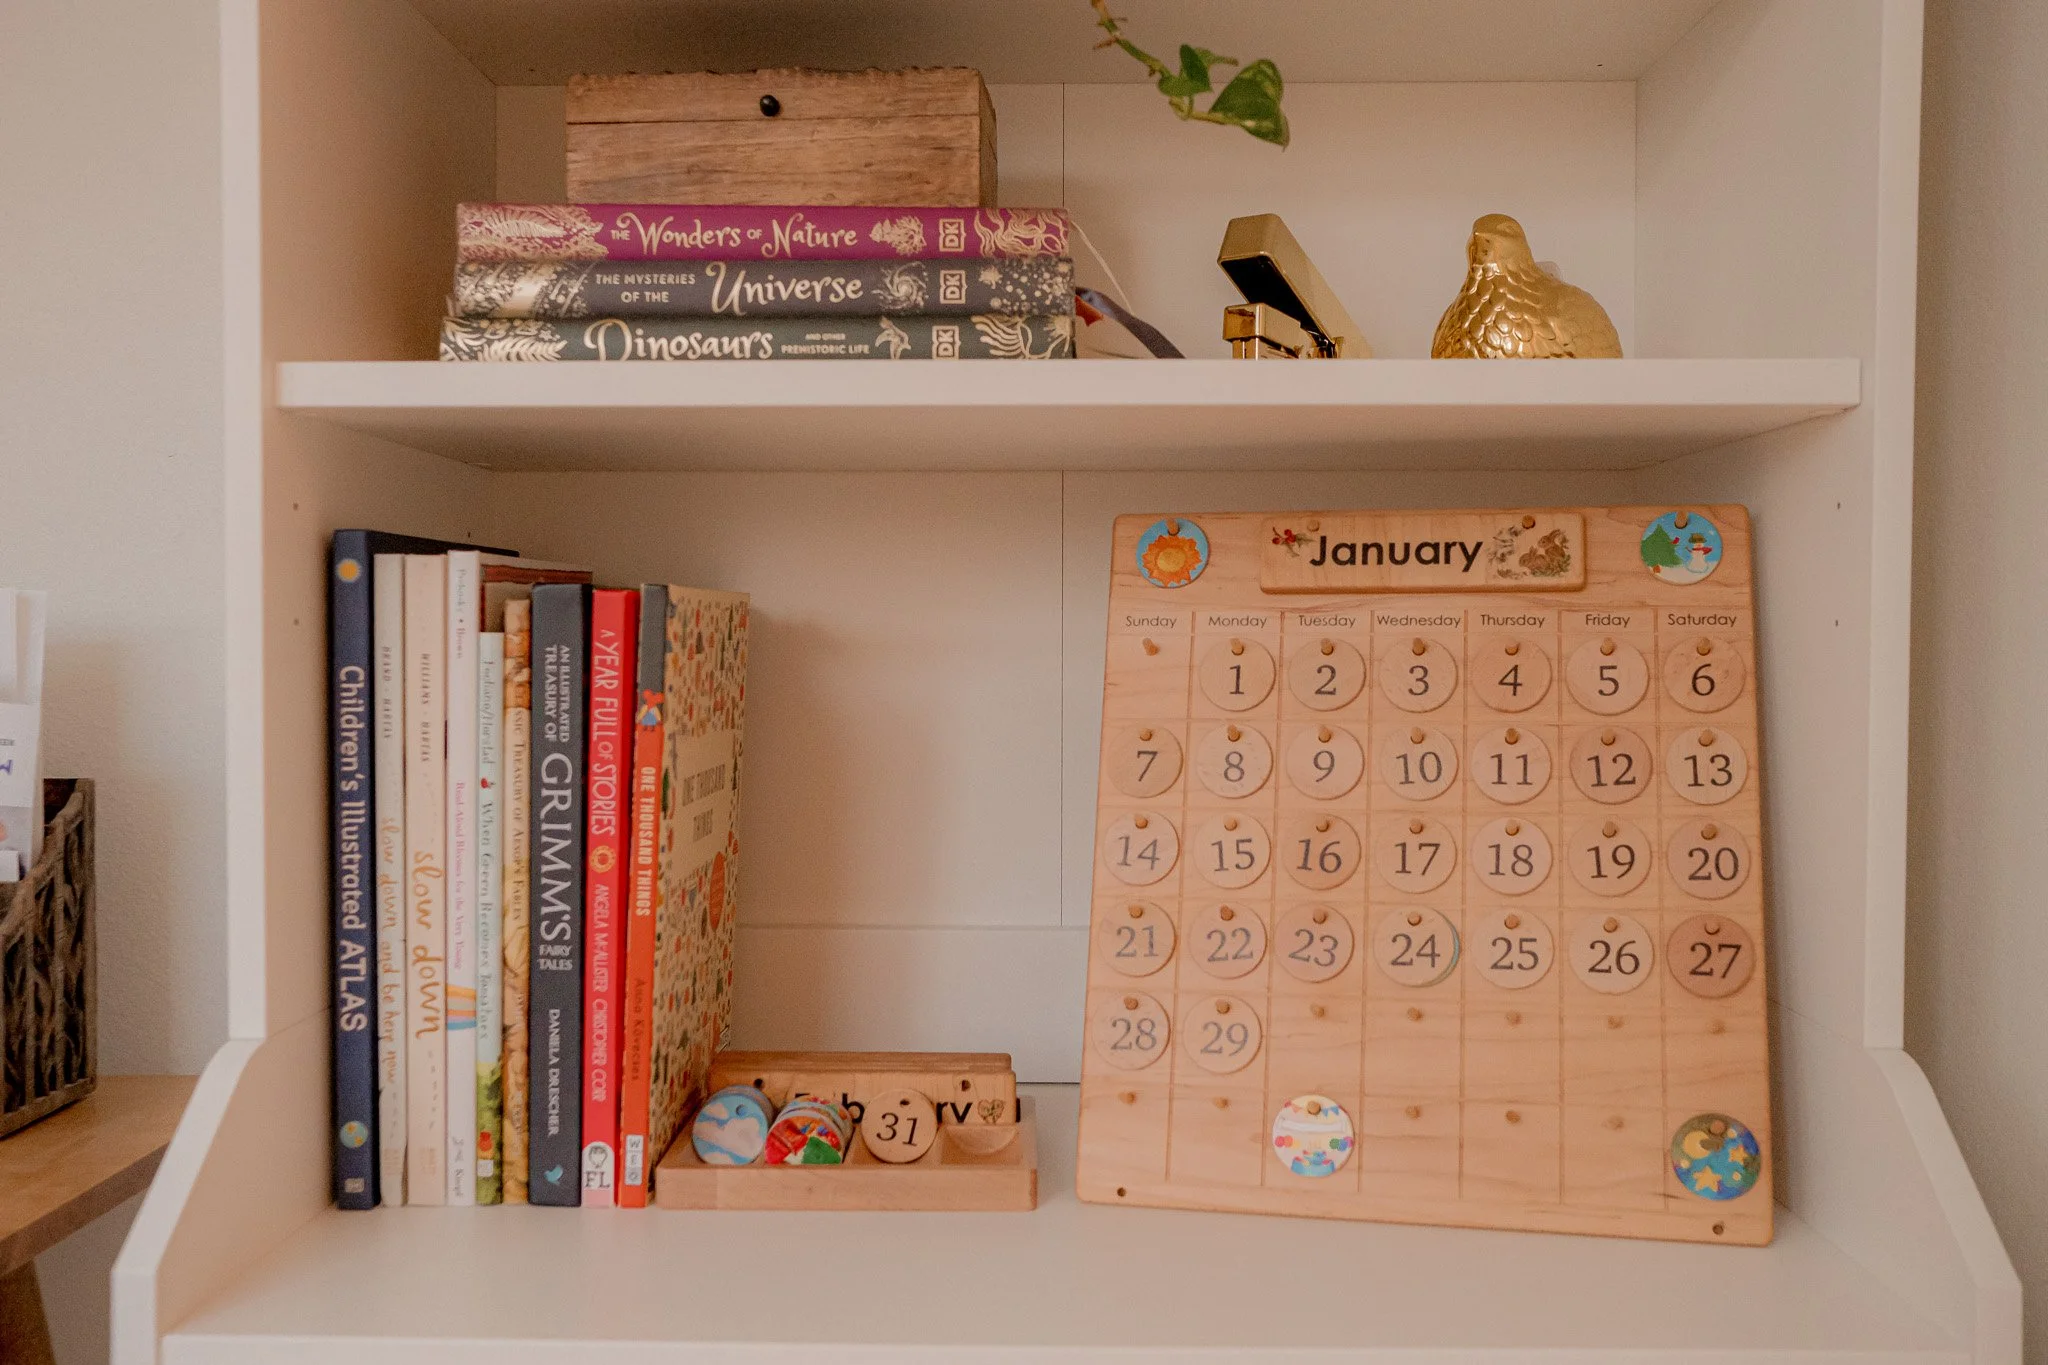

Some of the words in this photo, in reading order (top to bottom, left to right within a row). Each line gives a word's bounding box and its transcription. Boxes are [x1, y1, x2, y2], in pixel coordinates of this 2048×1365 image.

[611, 229, 631, 241] THE
[616, 211, 742, 255] Wonders
[746, 228, 762, 240] OF
[761, 212, 858, 258] Nature
[943, 222, 960, 249] DK
[596, 274, 620, 285] THE
[624, 274, 696, 285] MYSTERIES
[621, 292, 639, 303] OF
[643, 292, 669, 303] THE
[705, 261, 863, 316] Universe
[943, 272, 962, 300] DK
[583, 318, 774, 360] Dinosaurs
[781, 344, 847, 355] PREHISTORIC
[848, 344, 870, 355] LIFE
[935, 331, 956, 359] DK
[1309, 535, 1484, 573] January
[600, 629, 616, 639] A
[1125, 615, 1177, 629] Sunday
[1208, 615, 1268, 629] Monday
[1299, 615, 1356, 629] Tuesday
[1376, 614, 1461, 628] Wednesday
[1480, 614, 1545, 629] Thursday
[1585, 613, 1630, 628] Friday
[1667, 613, 1738, 628] Saturday
[559, 644, 570, 663] AN
[594, 641, 620, 690] YEAR
[544, 644, 558, 717] TREASURY
[1229, 664, 1245, 695] 1
[1314, 664, 1337, 696] 2
[1408, 665, 1430, 696] 3
[1498, 664, 1523, 697] 4
[1598, 665, 1620, 697] 5
[1691, 663, 1715, 697] 6
[558, 665, 571, 743] ILLUSTRATED
[592, 697, 619, 742] FULL
[338, 665, 367, 792] Children's
[544, 722, 557, 742] OF
[598, 741, 614, 760] OF
[1137, 750, 1158, 782] 7
[1223, 751, 1245, 783] 8
[1313, 750, 1335, 783] 9
[1395, 751, 1443, 785] 10
[1490, 753, 1533, 786] 11
[1587, 753, 1636, 787] 12
[1684, 754, 1733, 787] 13
[639, 766, 657, 792] ONE
[591, 762, 618, 837] STORIES
[381, 817, 401, 864] slow
[480, 800, 494, 845] When
[638, 797, 657, 865] THOUSAND
[339, 801, 367, 930] Illustrated
[540, 753, 573, 941] GRIMM'S
[1118, 835, 1160, 871] 14
[1211, 838, 1255, 872] 15
[1297, 838, 1342, 874] 16
[1395, 841, 1441, 876] 17
[1488, 843, 1534, 877] 18
[1587, 844, 1635, 879] 19
[1688, 847, 1739, 881] 20
[412, 851, 445, 930] slow
[480, 852, 495, 897] Green
[635, 869, 653, 917] THINGS
[380, 873, 400, 932] down
[454, 897, 465, 911] the
[594, 883, 610, 929] ANGELA
[380, 940, 401, 974] and
[538, 958, 573, 971] TALES
[539, 944, 571, 956] FAIRY
[1115, 925, 1159, 958] 21
[1206, 927, 1254, 963] 22
[1288, 928, 1339, 967] 23
[1390, 933, 1441, 968] 24
[1490, 936, 1539, 971] 25
[1588, 940, 1640, 975] 26
[1689, 942, 1742, 979] 27
[339, 939, 369, 1032] ATLAS
[382, 983, 401, 1004] be
[412, 945, 445, 1040] down
[634, 978, 647, 1013] Anna
[382, 1011, 401, 1042] here
[548, 1008, 561, 1065] DANIELA
[591, 998, 608, 1066] CHRISTOPHER
[1110, 1017, 1157, 1051] 28
[1200, 1021, 1249, 1057] 29
[382, 1051, 399, 1084] now
[591, 1068, 607, 1103] CORR
[547, 1068, 560, 1138] DRESCHER
[876, 1112, 921, 1147] 31
[585, 1170, 611, 1188] FL
